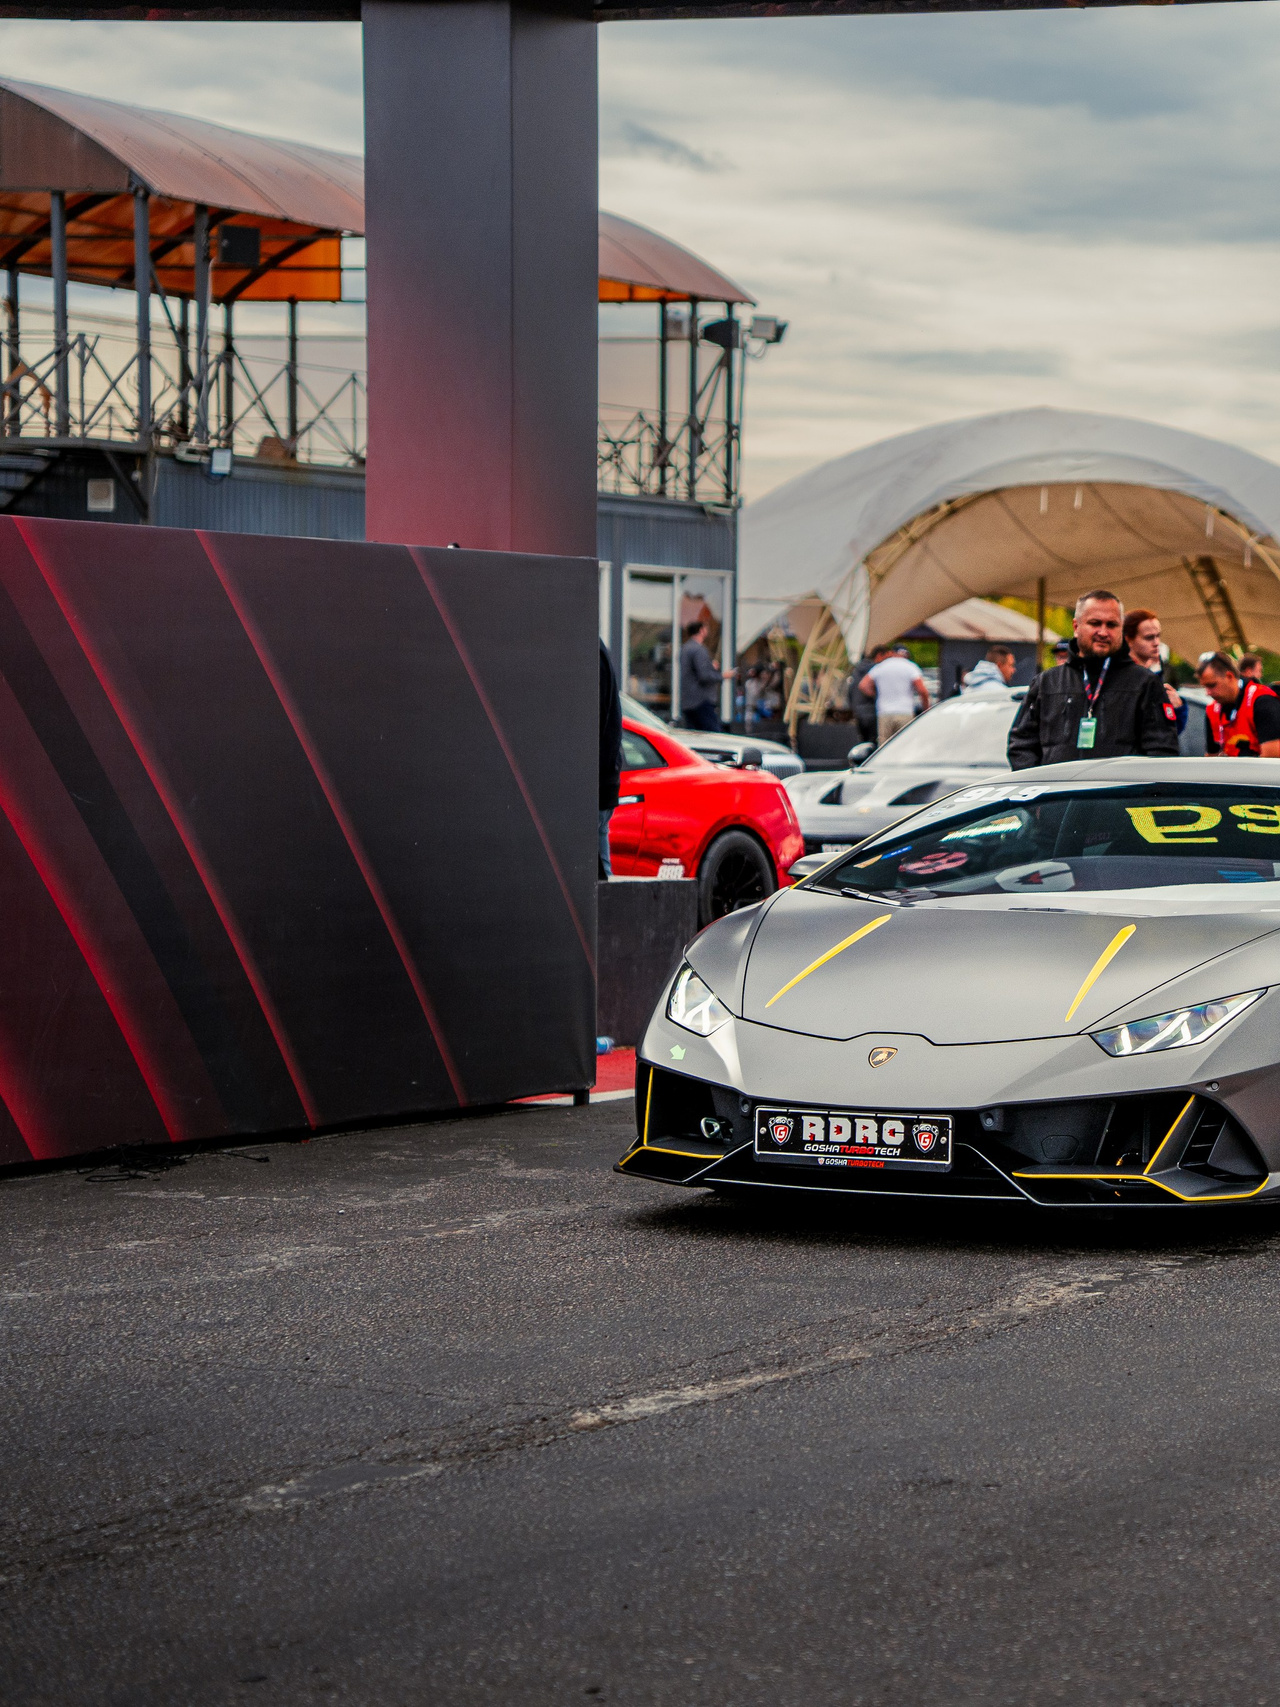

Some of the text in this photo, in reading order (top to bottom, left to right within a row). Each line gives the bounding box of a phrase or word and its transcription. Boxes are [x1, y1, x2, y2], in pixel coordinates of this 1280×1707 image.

[953, 785, 1051, 803] 919
[801, 1115, 905, 1146] RDRC
[804, 1143, 901, 1157] GOSHATURBOTECH
[825, 1158, 885, 1168] GOSHATURBOTECH
